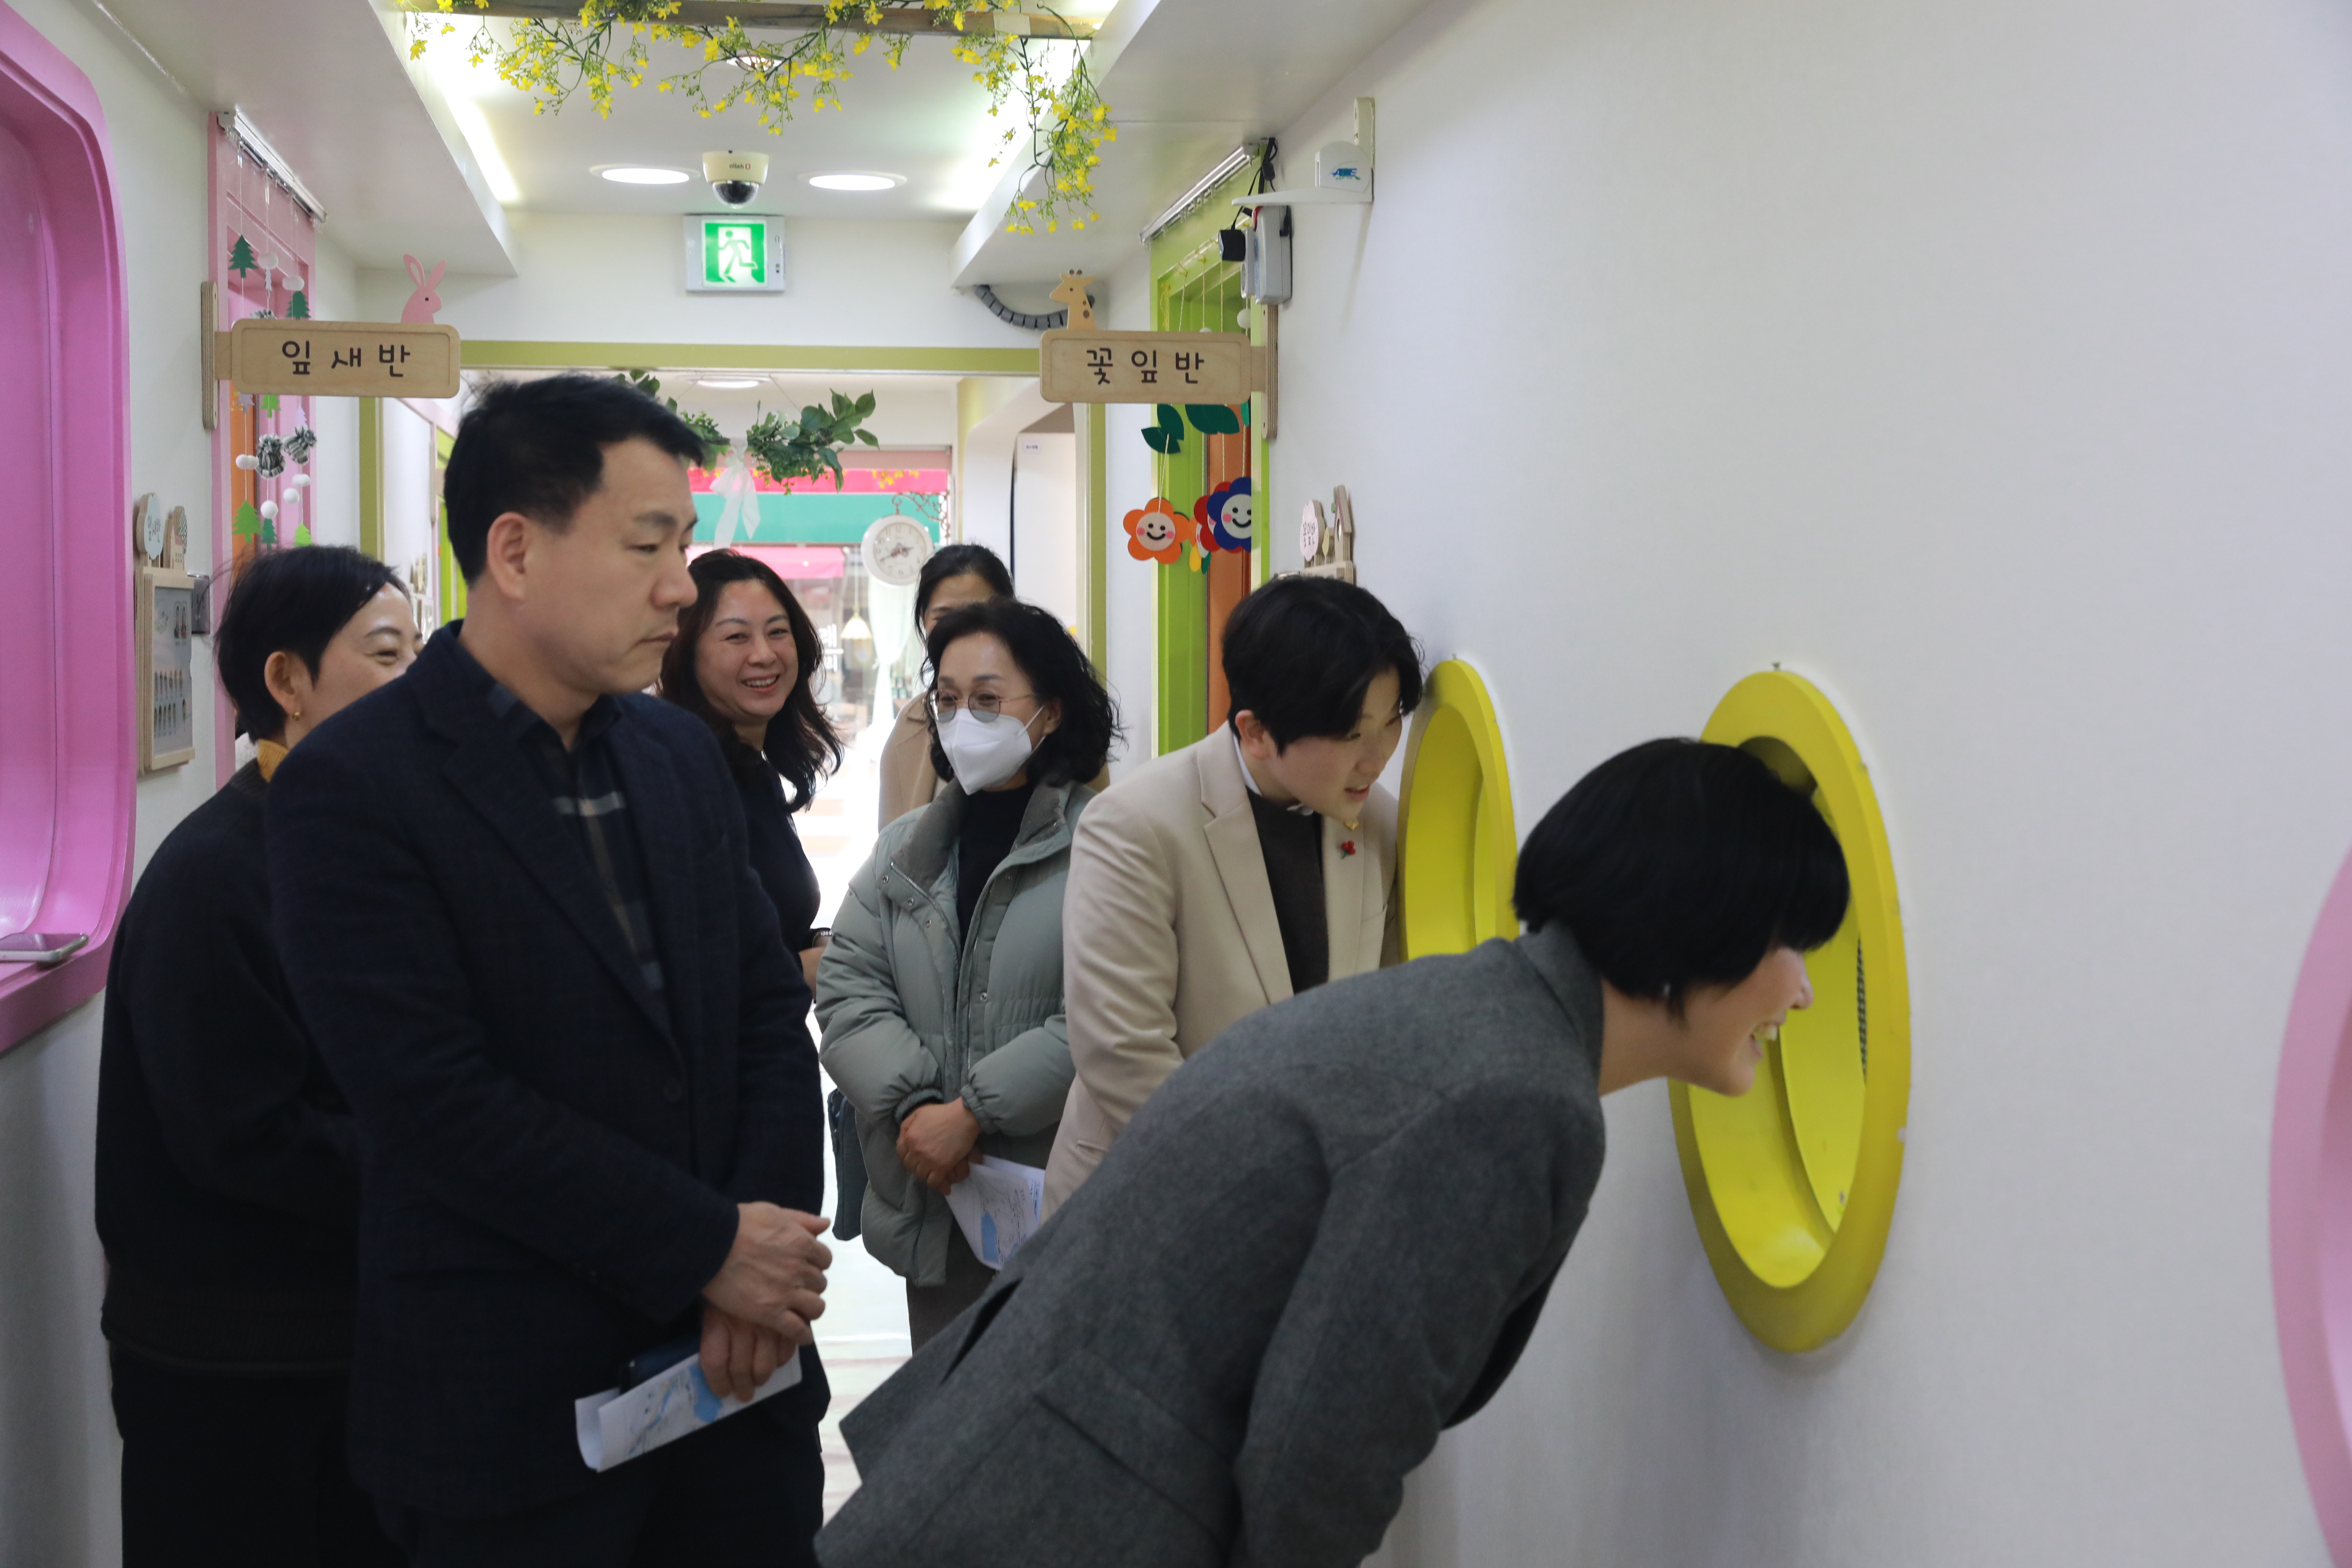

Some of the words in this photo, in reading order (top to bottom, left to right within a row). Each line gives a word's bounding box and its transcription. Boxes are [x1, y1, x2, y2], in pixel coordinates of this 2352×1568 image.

[281, 340, 411, 378] 잎새반
[1086, 347, 1205, 385] 꽃잎반
[147, 515, 161, 543] 잎새반
[1302, 522, 1316, 548] 꽃잎반
